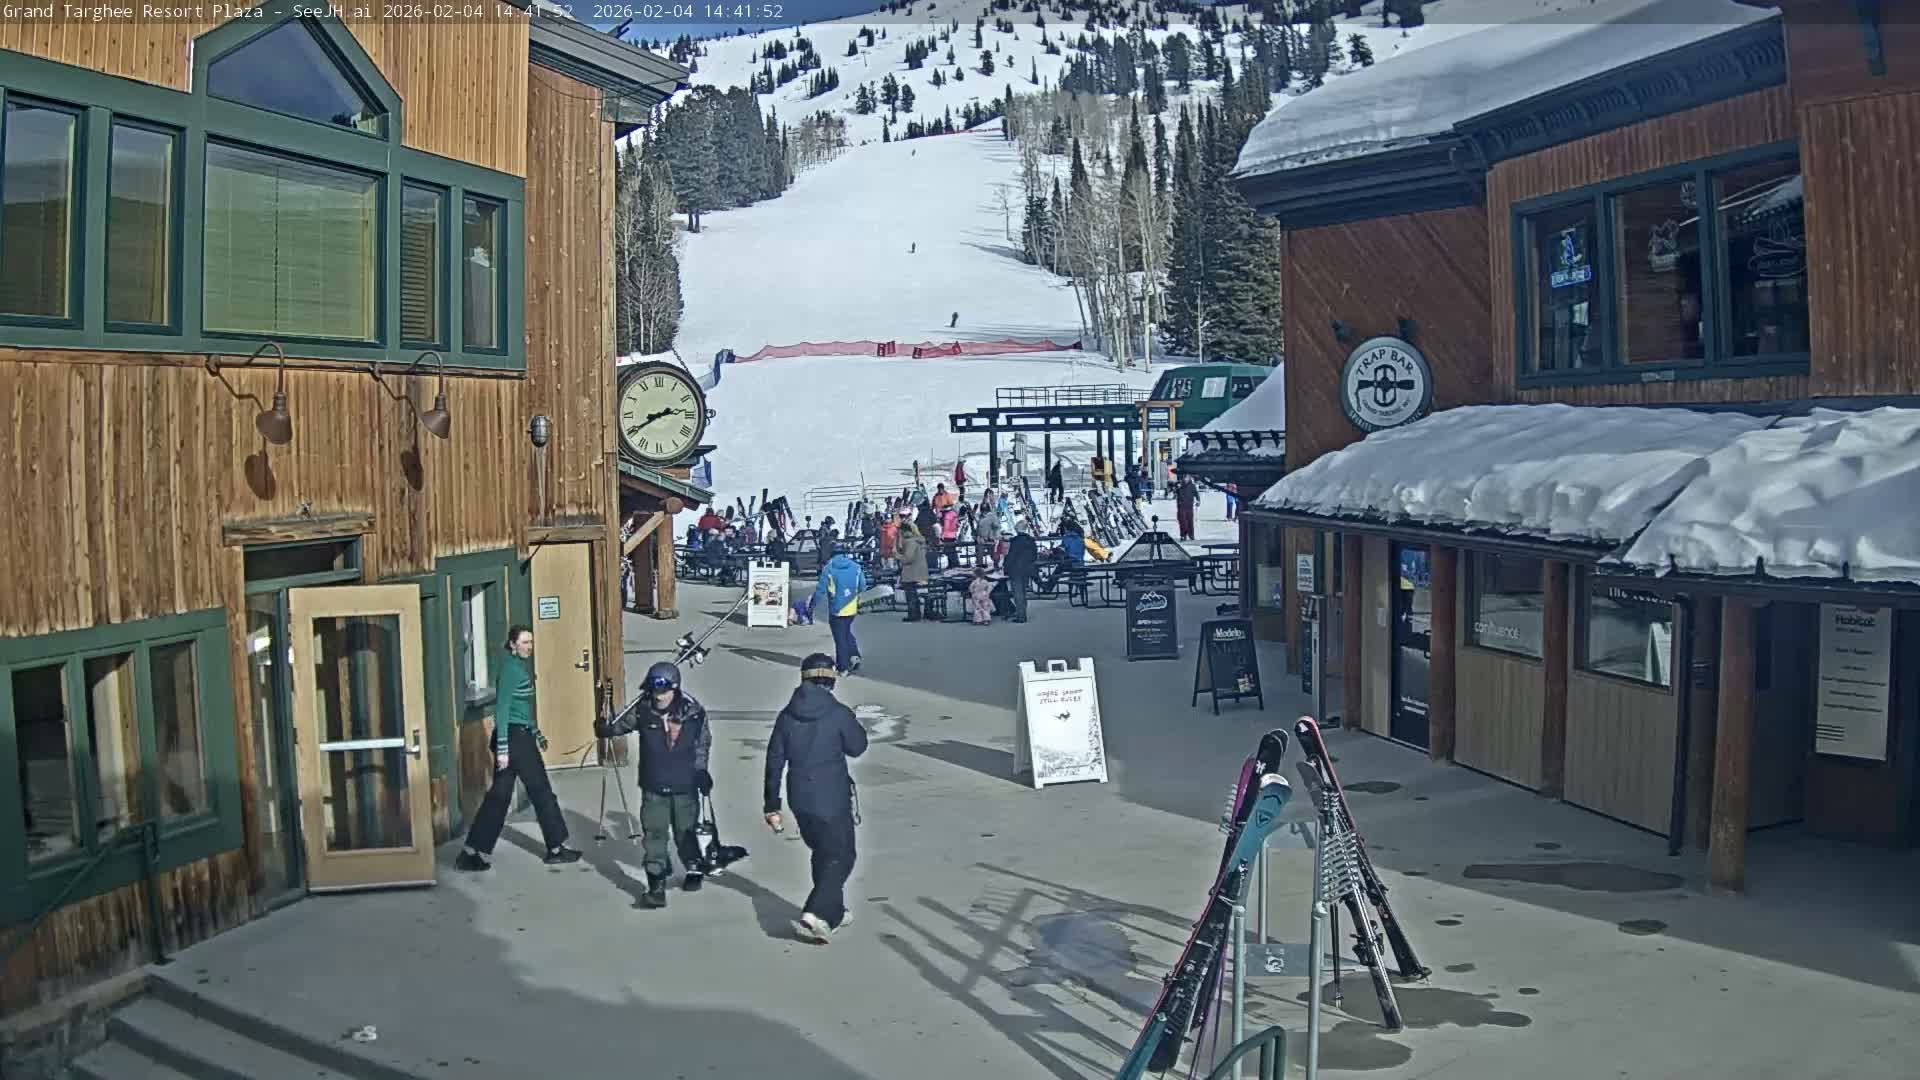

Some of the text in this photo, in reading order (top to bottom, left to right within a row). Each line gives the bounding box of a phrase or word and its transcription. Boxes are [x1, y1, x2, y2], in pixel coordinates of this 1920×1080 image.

[1356, 349, 1415, 376] TRAP BAR
[1215, 627, 1242, 638] Modelo
